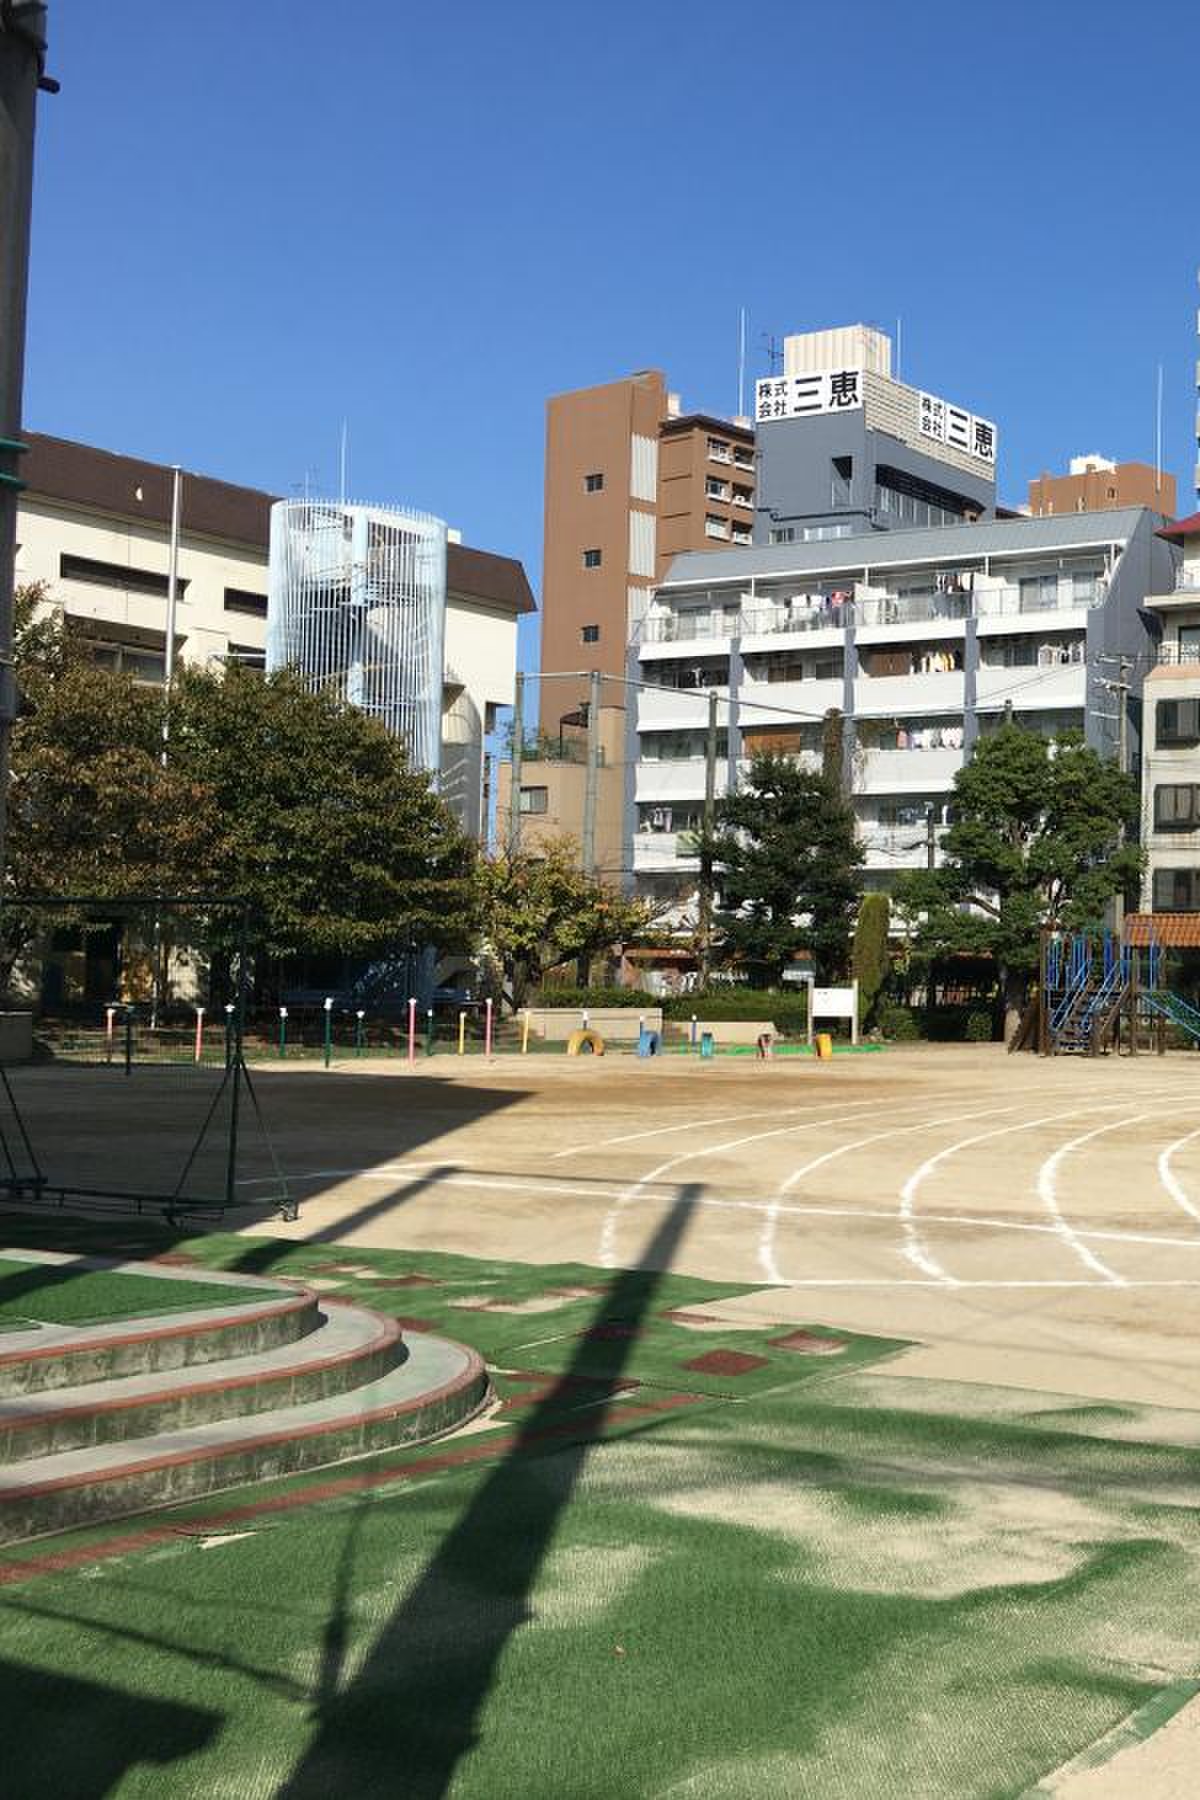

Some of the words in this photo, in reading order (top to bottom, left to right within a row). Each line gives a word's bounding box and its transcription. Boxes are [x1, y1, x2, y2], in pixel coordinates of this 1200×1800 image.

[759, 381, 788, 397] 株式
[794, 371, 859, 412] 三恵
[759, 400, 787, 418] 会社
[948, 409, 993, 458] 三恵
